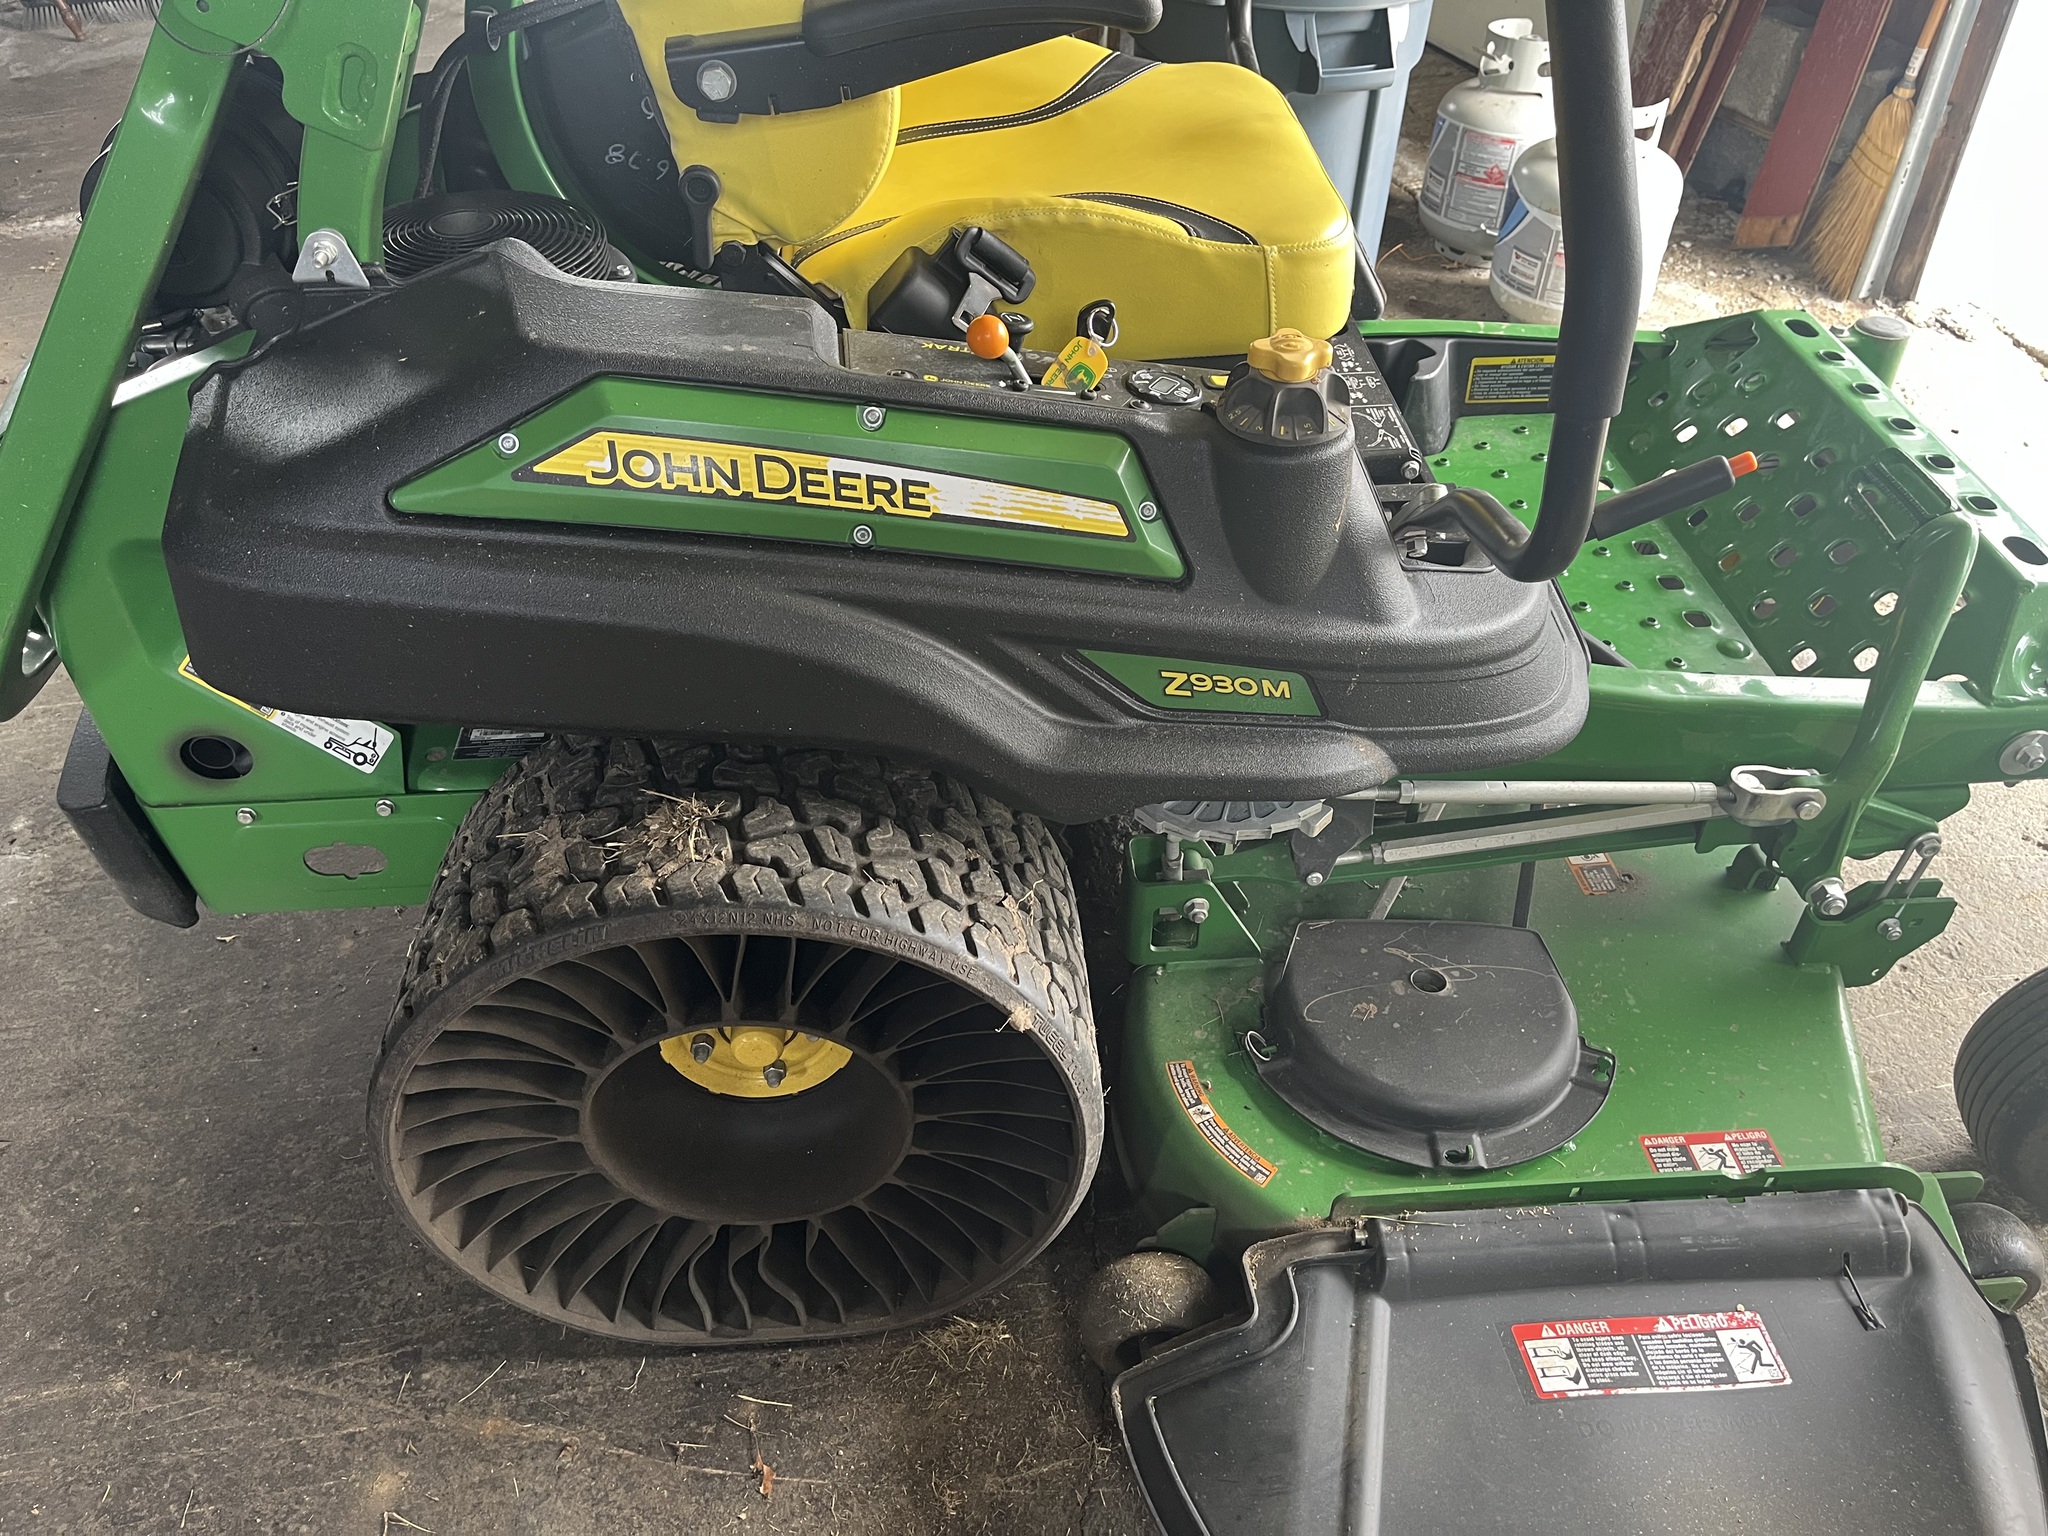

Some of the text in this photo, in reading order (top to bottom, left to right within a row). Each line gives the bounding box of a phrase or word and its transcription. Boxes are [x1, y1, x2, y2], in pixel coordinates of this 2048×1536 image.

[922, 342, 973, 355] TRAK
[1064, 340, 1083, 363] JOHN
[590, 440, 932, 513] JOHN DEERE
[1159, 670, 1291, 700] Z930M
[763, 912, 796, 928] NHS
[811, 917, 843, 934] NOT
[848, 923, 879, 943] FOR
[884, 933, 946, 966] HIGHWAY
[950, 959, 977, 980] USE
[1650, 1130, 1768, 1145] DANGER PELIGRO
[1555, 1314, 1728, 1336] DANGER PELIGRO
